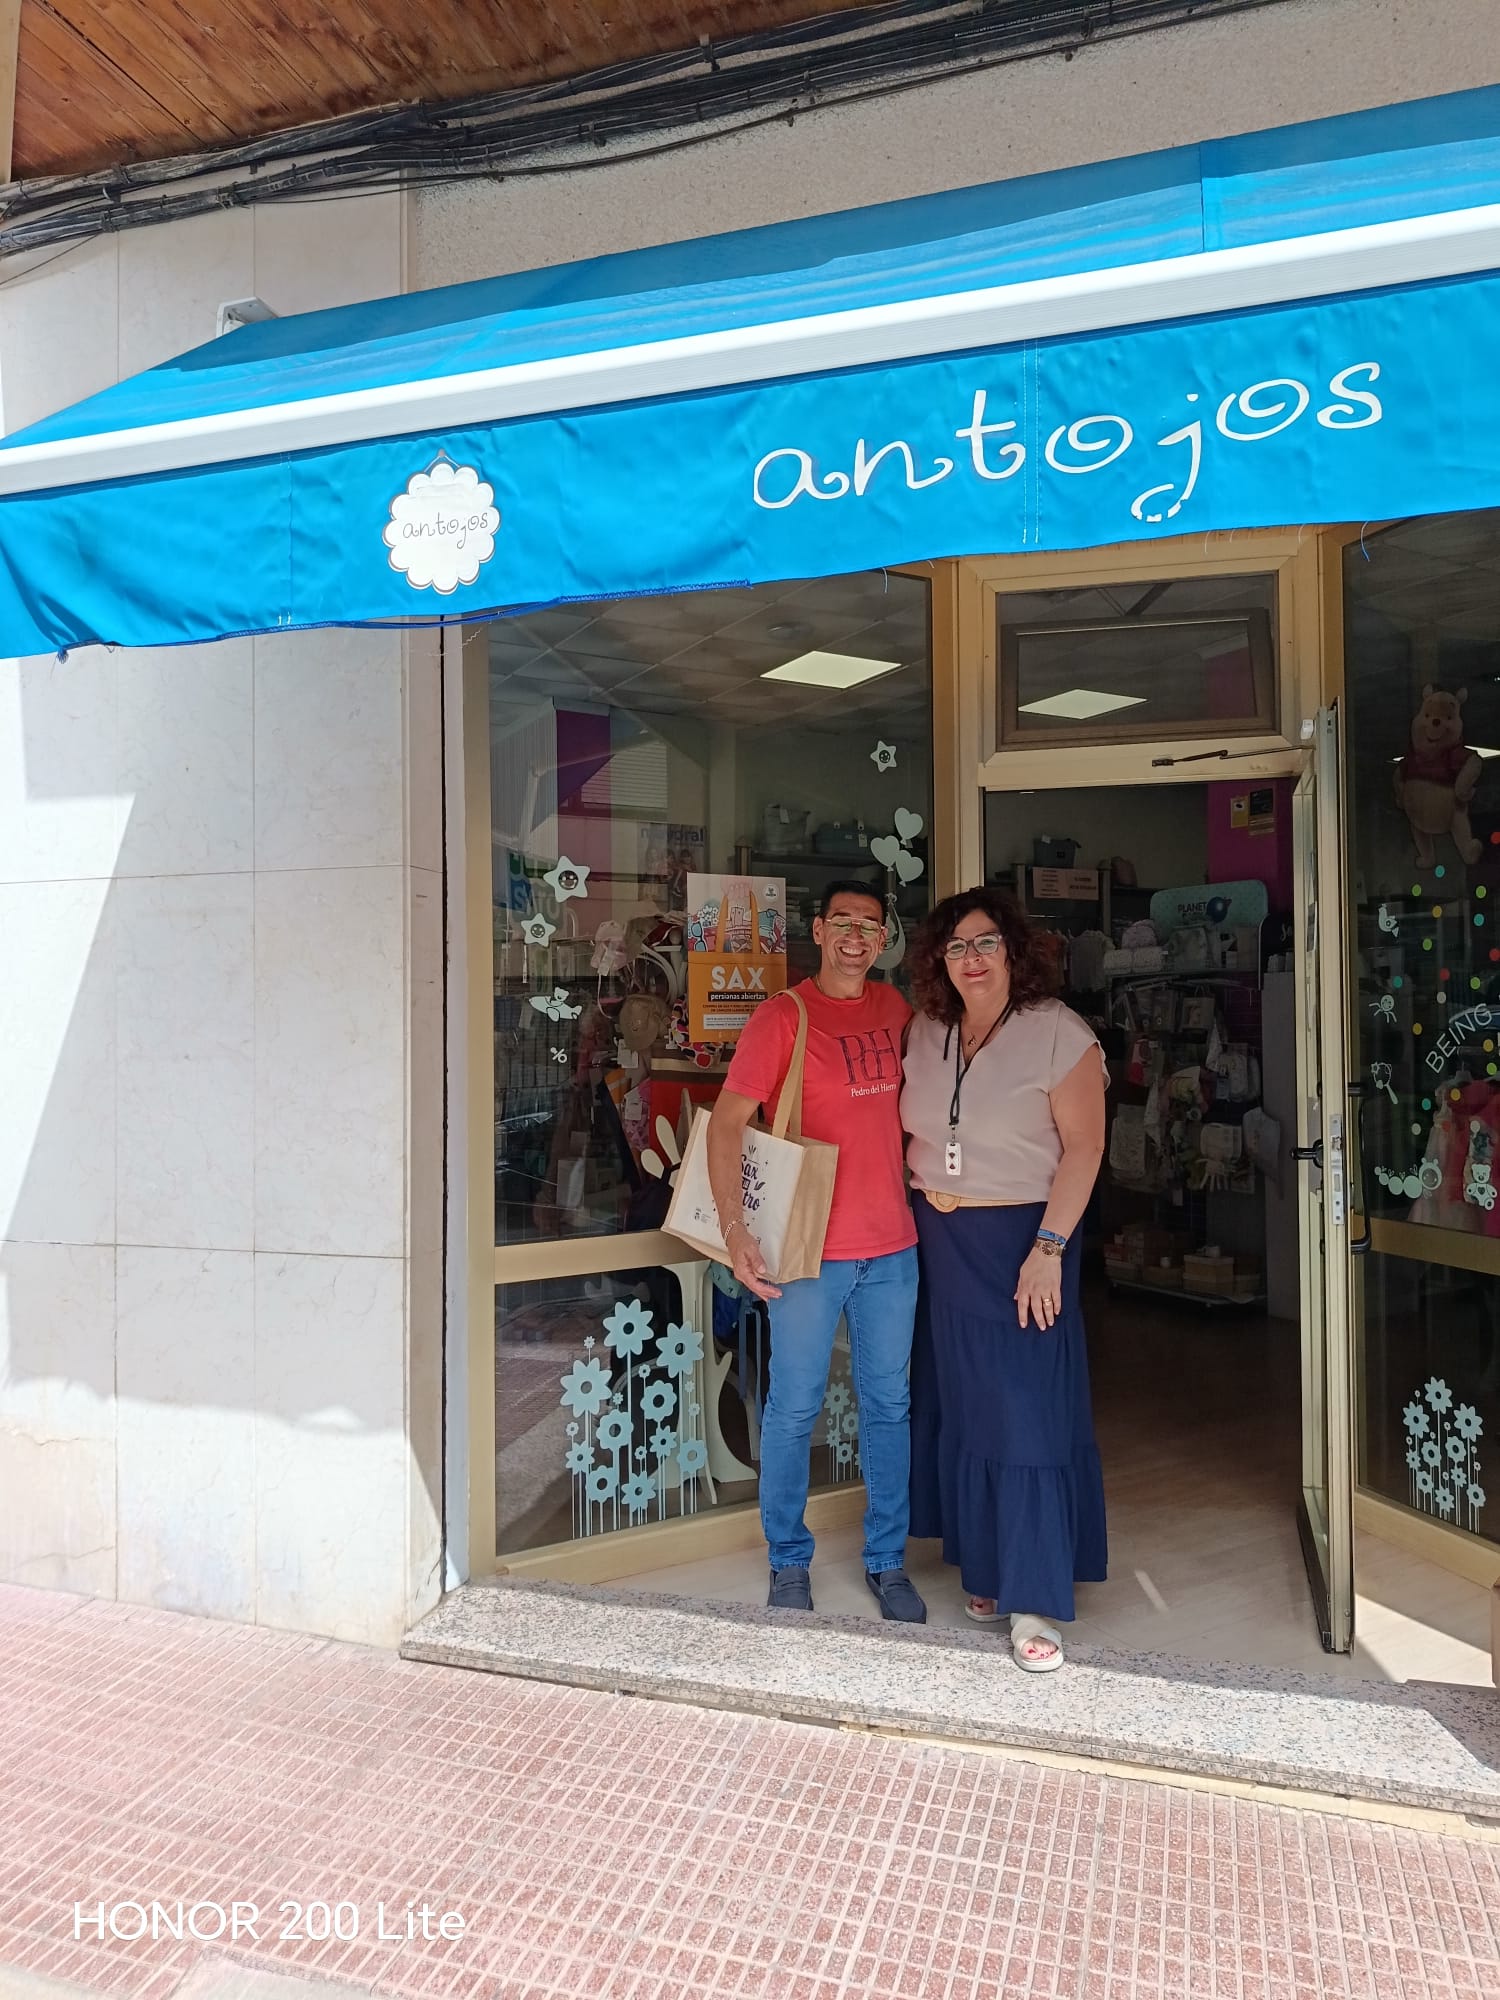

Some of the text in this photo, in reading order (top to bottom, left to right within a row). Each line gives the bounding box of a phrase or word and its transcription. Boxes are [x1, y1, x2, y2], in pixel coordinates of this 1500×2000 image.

[753, 361, 1384, 522] antojos
[402, 511, 489, 550] antojos
[1177, 901, 1208, 913] PLANET
[711, 965, 766, 990] SAX
[710, 992, 766, 1001] persianas abiertas
[1425, 1003, 1493, 1074] BEING
[851, 1087, 870, 1097] Pedro
[871, 1085, 880, 1093] del
